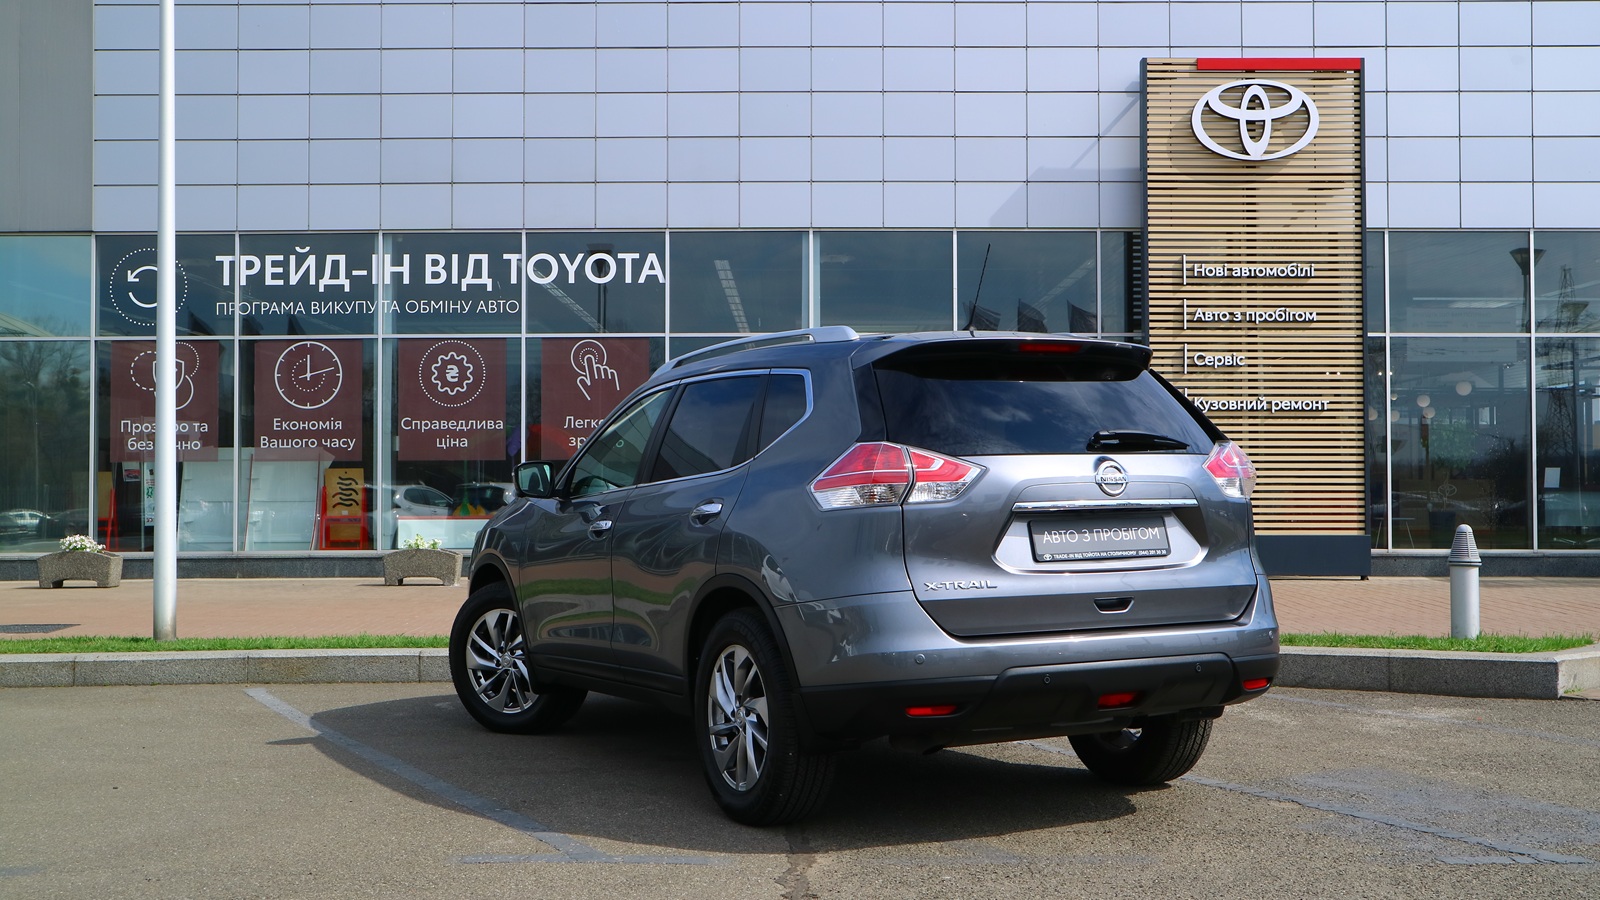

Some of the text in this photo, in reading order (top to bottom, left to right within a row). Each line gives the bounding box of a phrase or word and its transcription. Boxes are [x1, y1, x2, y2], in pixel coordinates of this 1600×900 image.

[215, 246, 666, 292] ТРЕЙД-ІН ВІД TOYOTA
[1193, 263, 1315, 277] Нові автомобілі
[216, 300, 520, 316] ПРОГРАМА ВИКУПУ ТА ОБМІНУ АВТО
[1193, 307, 1317, 324] Авто з пробігом
[1193, 352, 1246, 369] Сервіс
[1194, 396, 1330, 413] Кузовний ремонт
[193, 422, 209, 432] та
[273, 417, 342, 430] Економія
[401, 417, 504, 432] Справедлива
[260, 435, 356, 451] Вашого часу
[436, 435, 468, 449] ціна
[1043, 529, 1079, 544] АВТО
[1094, 527, 1160, 541] ПРОБІГОМ
[924, 580, 998, 592] X-TRAIL
